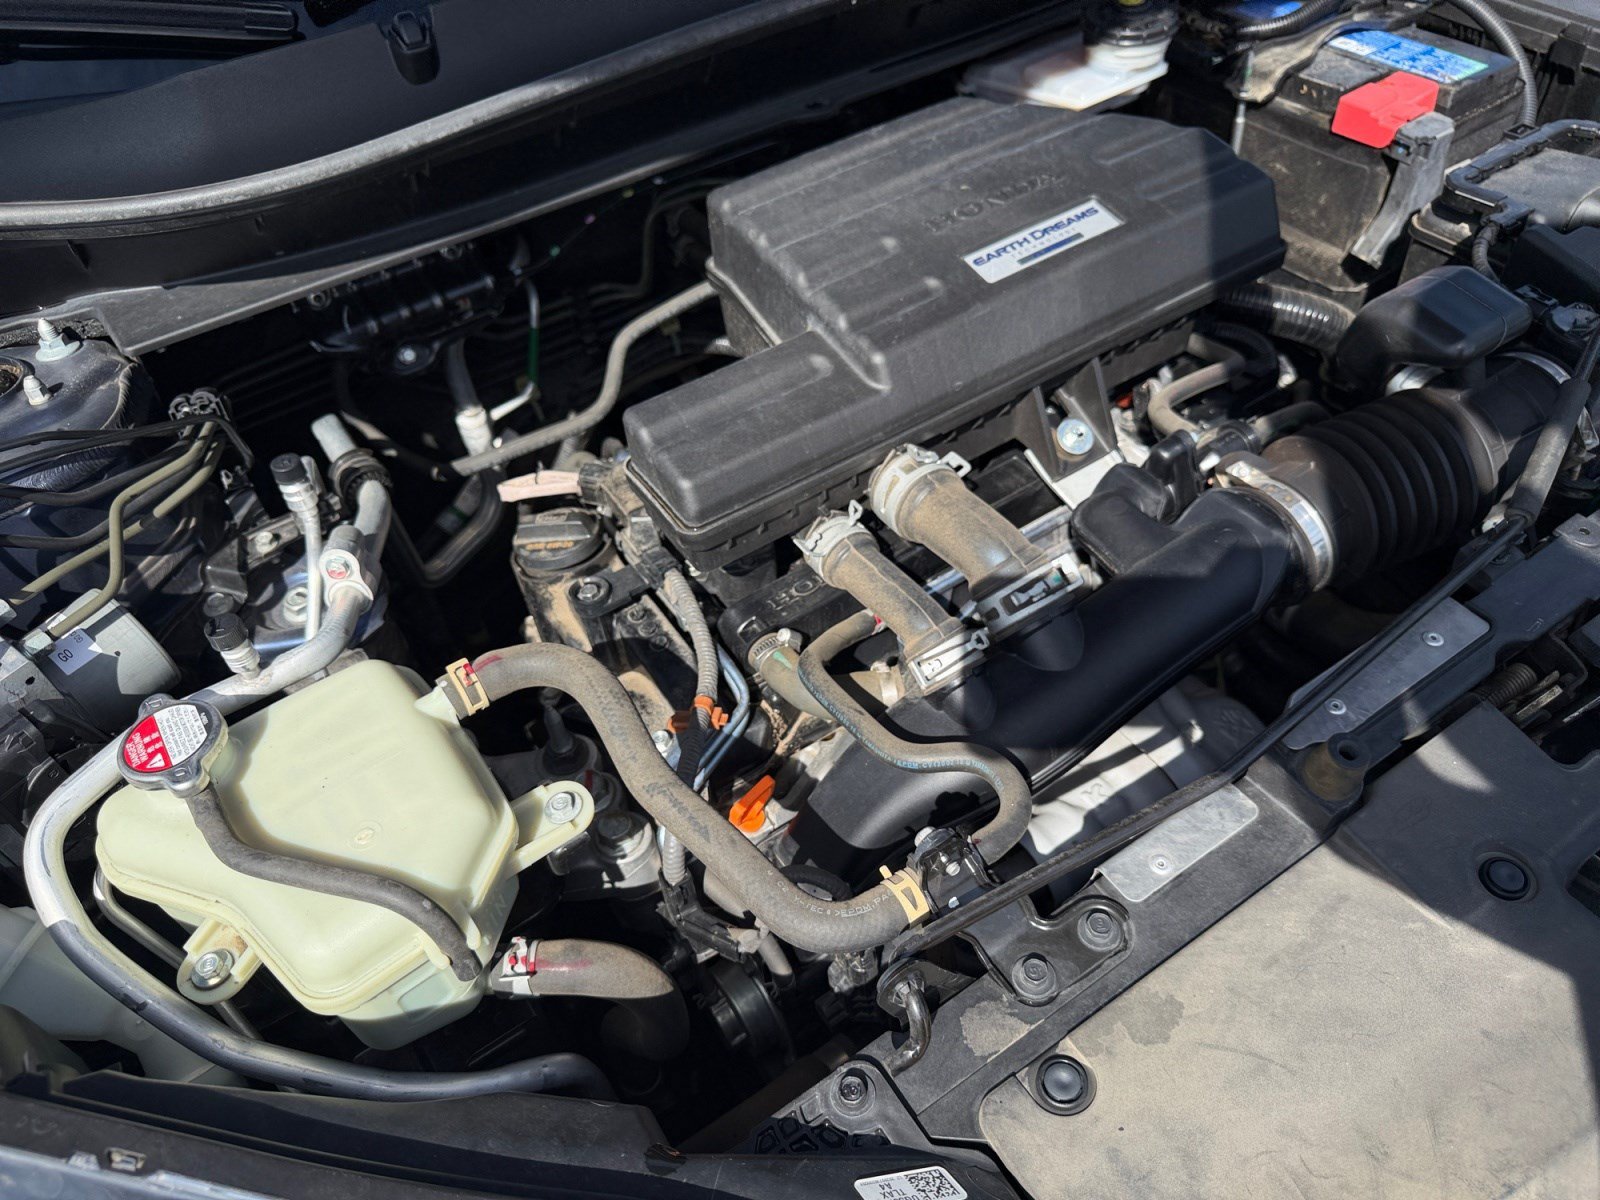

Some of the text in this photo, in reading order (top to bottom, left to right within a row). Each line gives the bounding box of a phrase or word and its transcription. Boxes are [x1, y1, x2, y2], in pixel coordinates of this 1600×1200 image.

[972, 207, 1099, 267] EARTH DREAMS
[125, 740, 141, 768] DANGER
[132, 732, 149, 763] WARNING
[879, 1182, 893, 1190] A4
